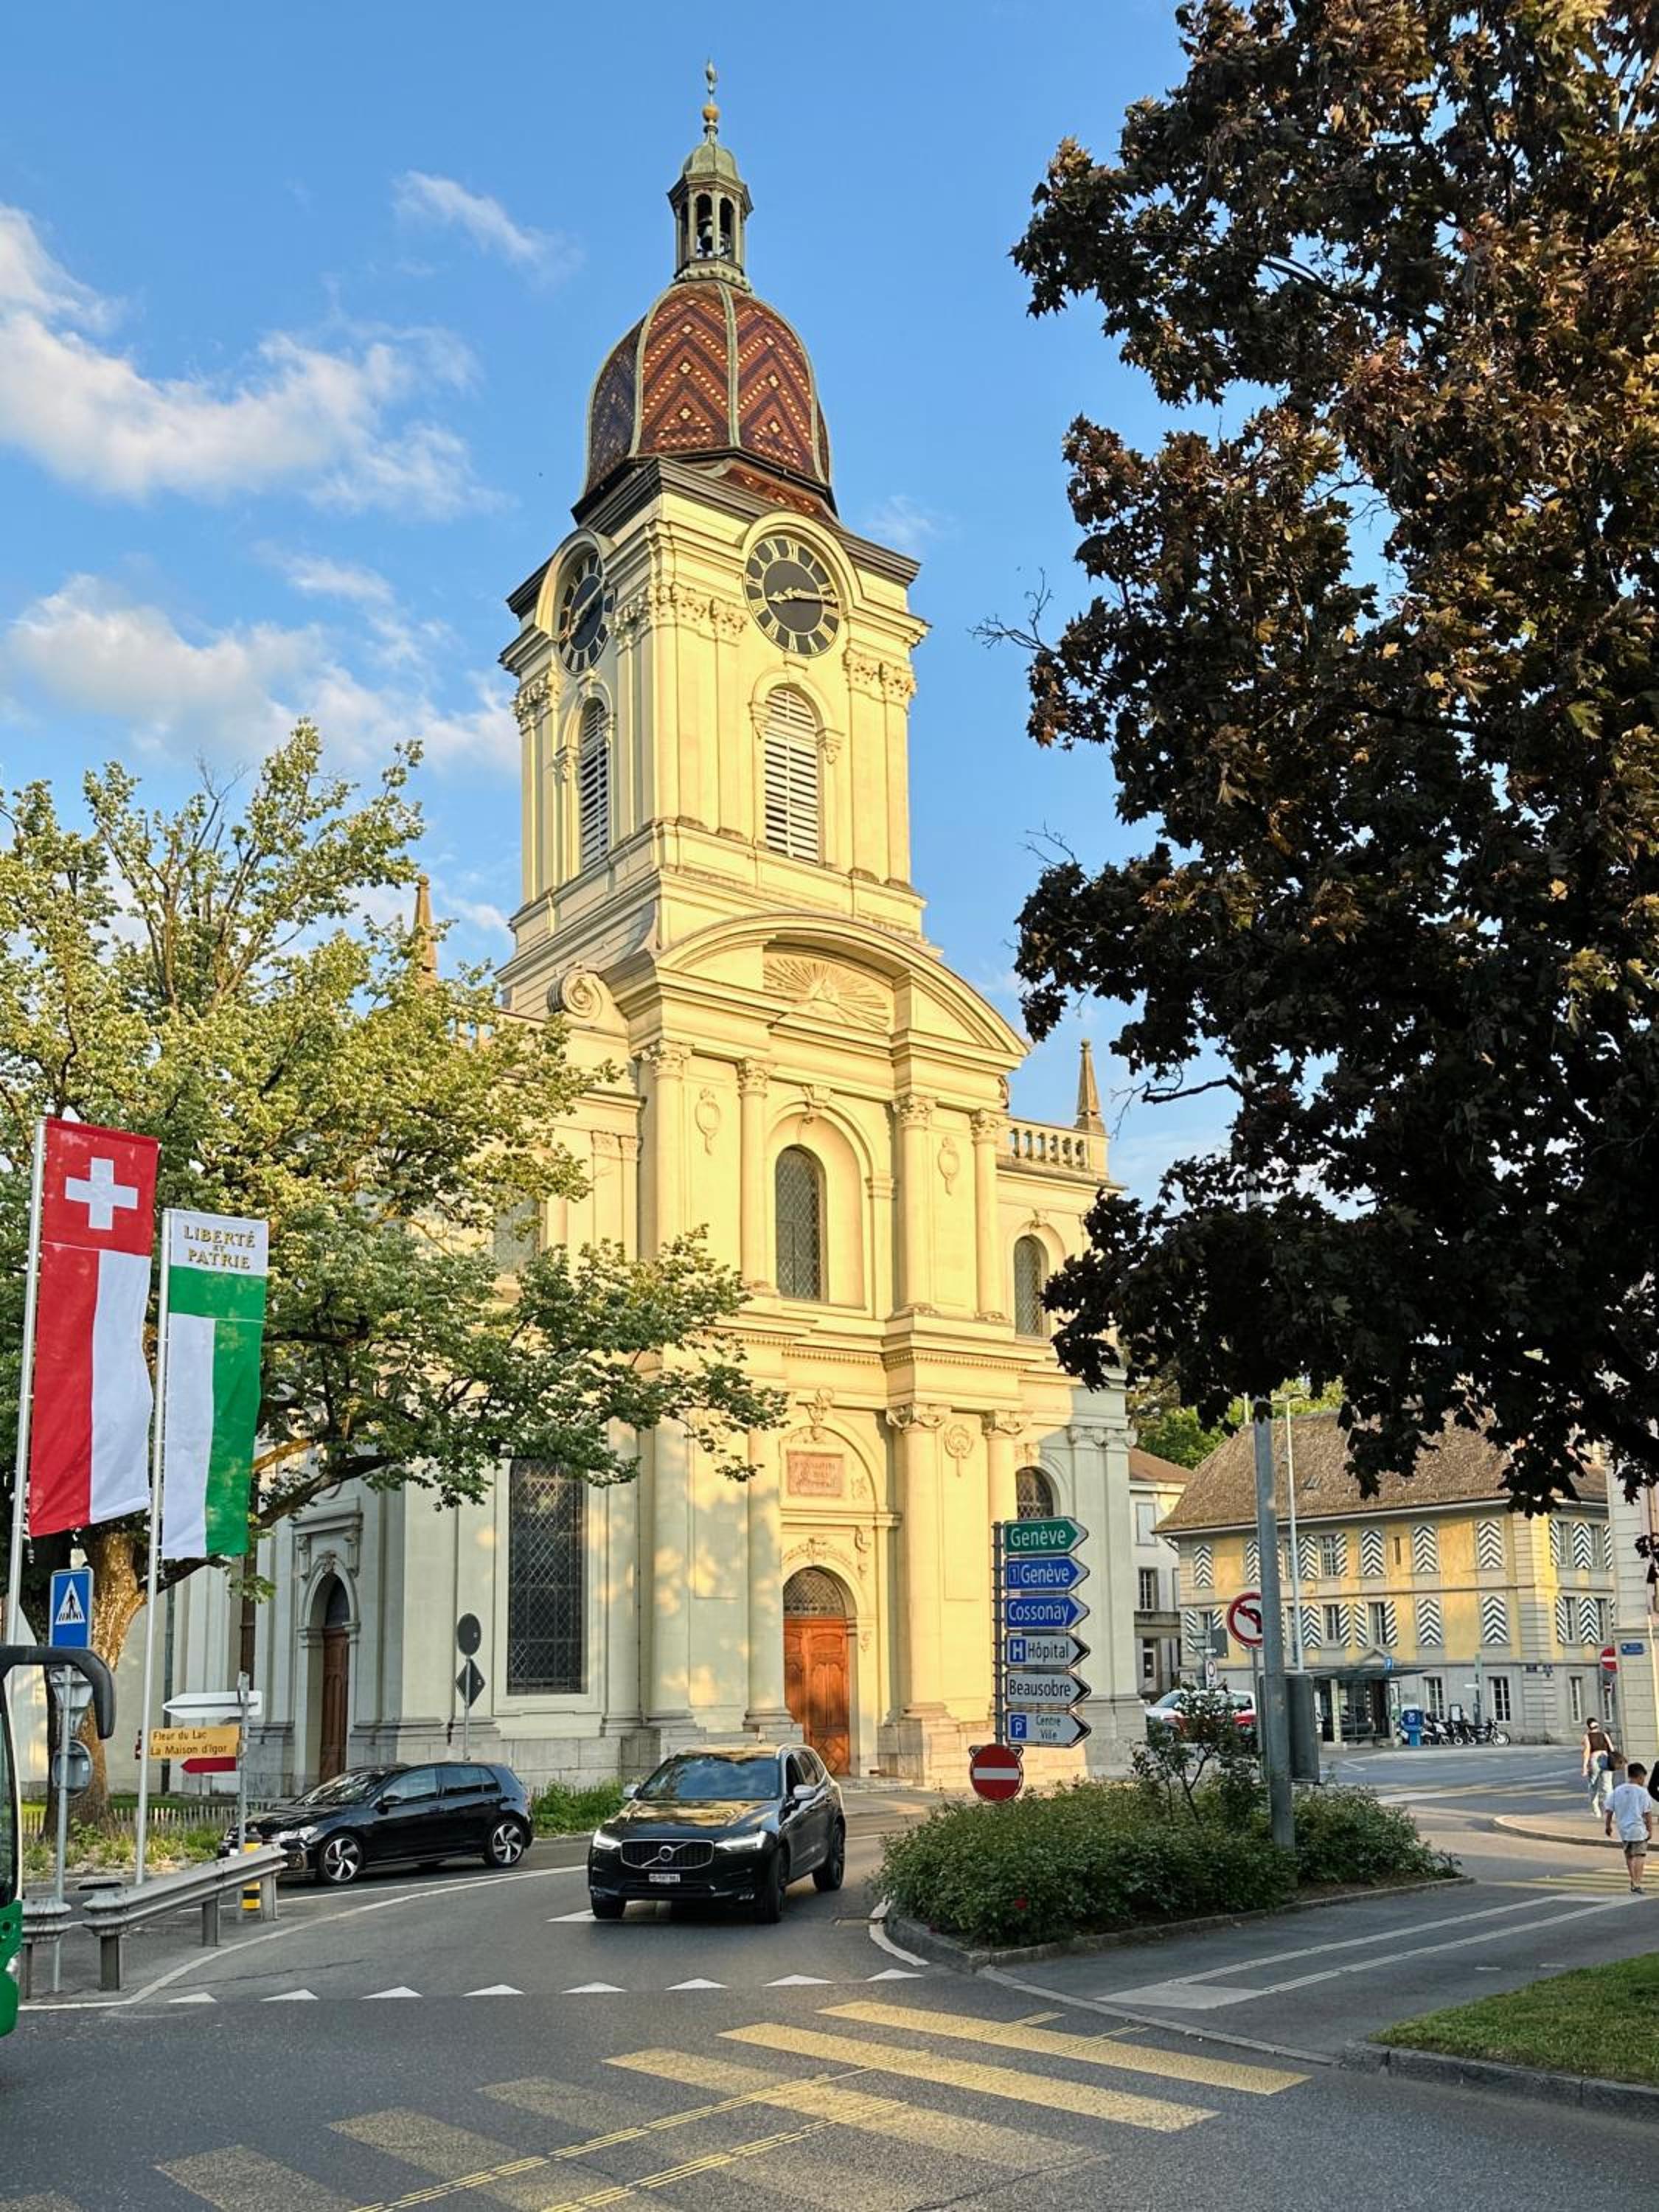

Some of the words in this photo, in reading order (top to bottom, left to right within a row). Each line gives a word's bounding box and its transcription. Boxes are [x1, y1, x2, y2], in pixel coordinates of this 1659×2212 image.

[184, 1225, 256, 1248] LIBERTÉ
[188, 1247, 251, 1270] PATRIE
[1010, 1525, 1066, 1547] Genève
[1020, 1563, 1070, 1583] Genève
[1008, 1601, 1068, 1625] Cossonay
[1012, 1641, 1023, 1660] H
[1028, 1641, 1068, 1662] Hôpital
[1009, 1679, 1071, 1697] Beausobre
[1015, 1722, 1023, 1736] P
[1036, 1715, 1061, 1726] Centre
[153, 1731, 175, 1741] Fleur
[178, 1731, 189, 1740] du
[192, 1730, 207, 1740] Lac
[1040, 1729, 1058, 1739] Ville
[150, 1747, 161, 1756] La
[164, 1745, 198, 1755] Maison
